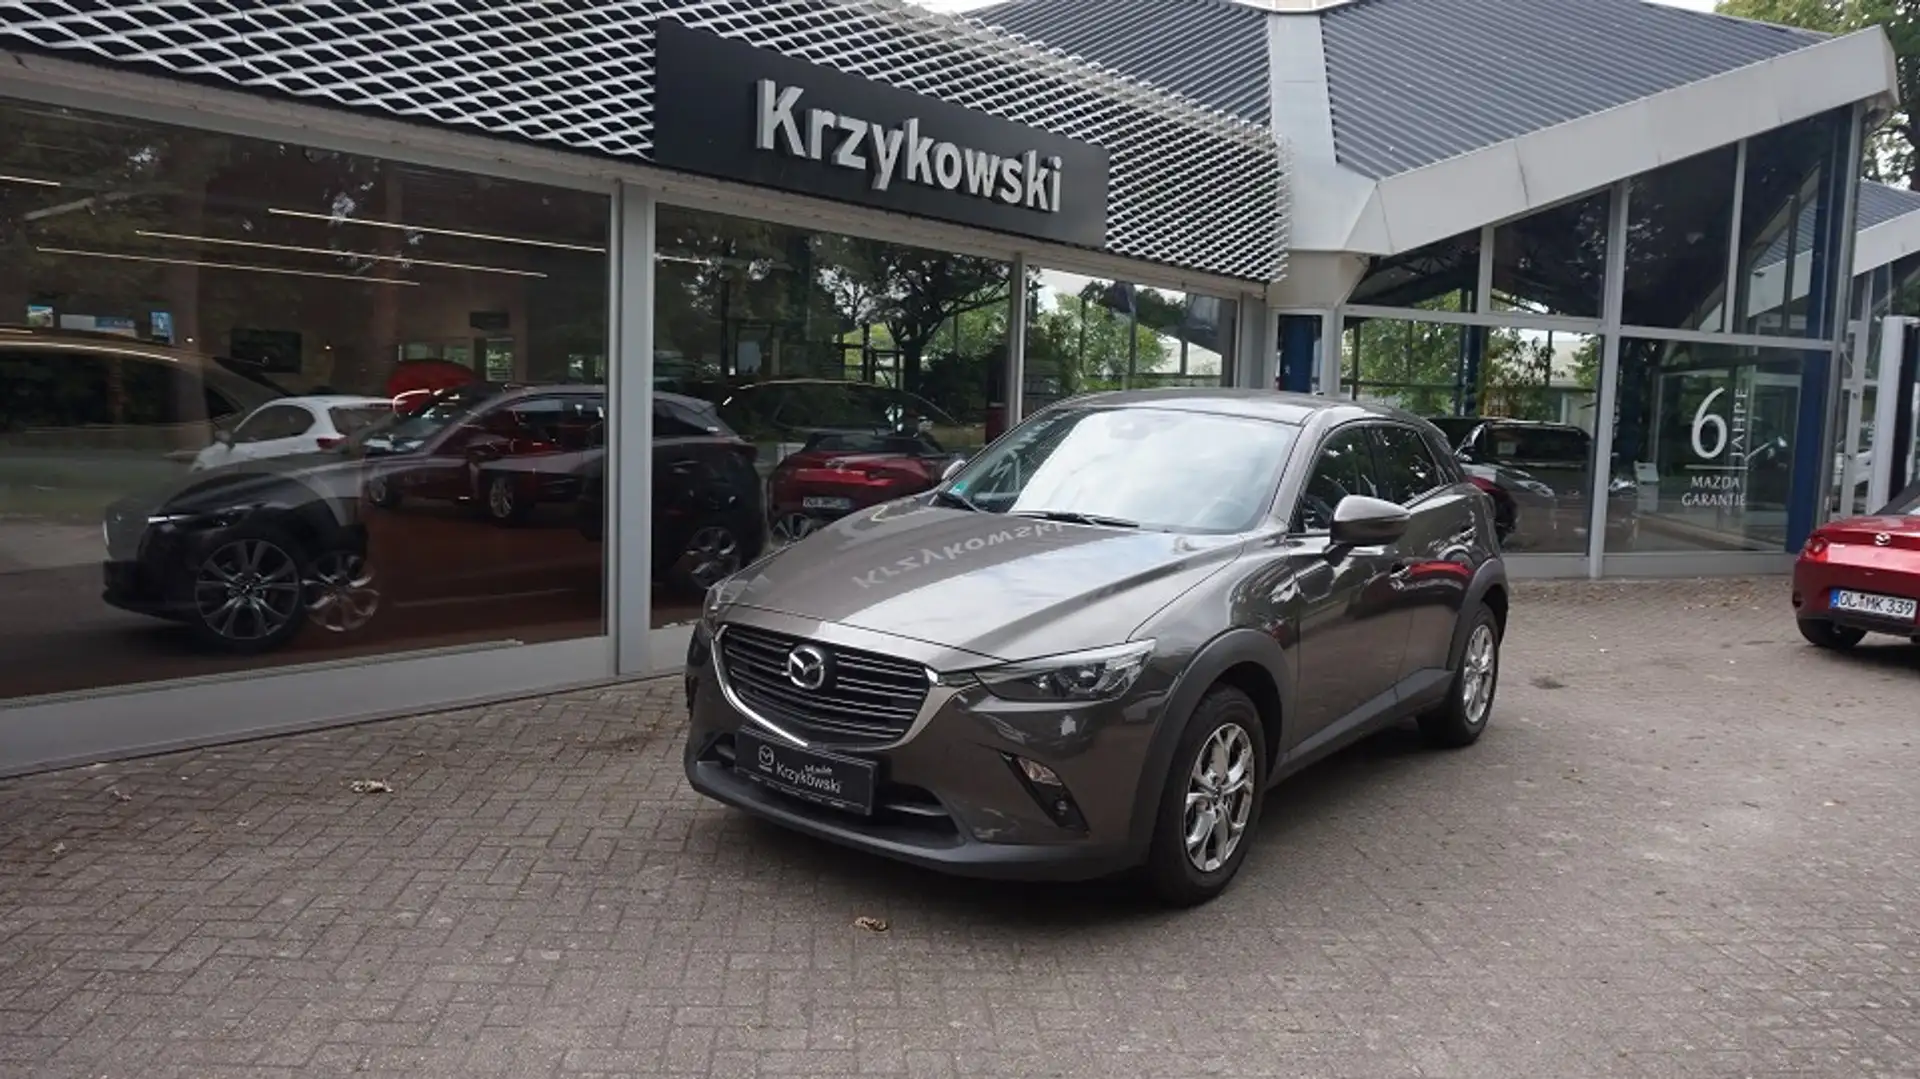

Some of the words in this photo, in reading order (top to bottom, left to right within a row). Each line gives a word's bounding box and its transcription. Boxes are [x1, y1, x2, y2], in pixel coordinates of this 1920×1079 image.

[756, 78, 1063, 213] Krzykowski
[1691, 387, 1725, 459] 6
[1690, 475, 1741, 490] MAZDA
[1681, 492, 1747, 507] GARANTIE
[1886, 599, 1914, 615] 339
[776, 761, 841, 794] Krzykowski
